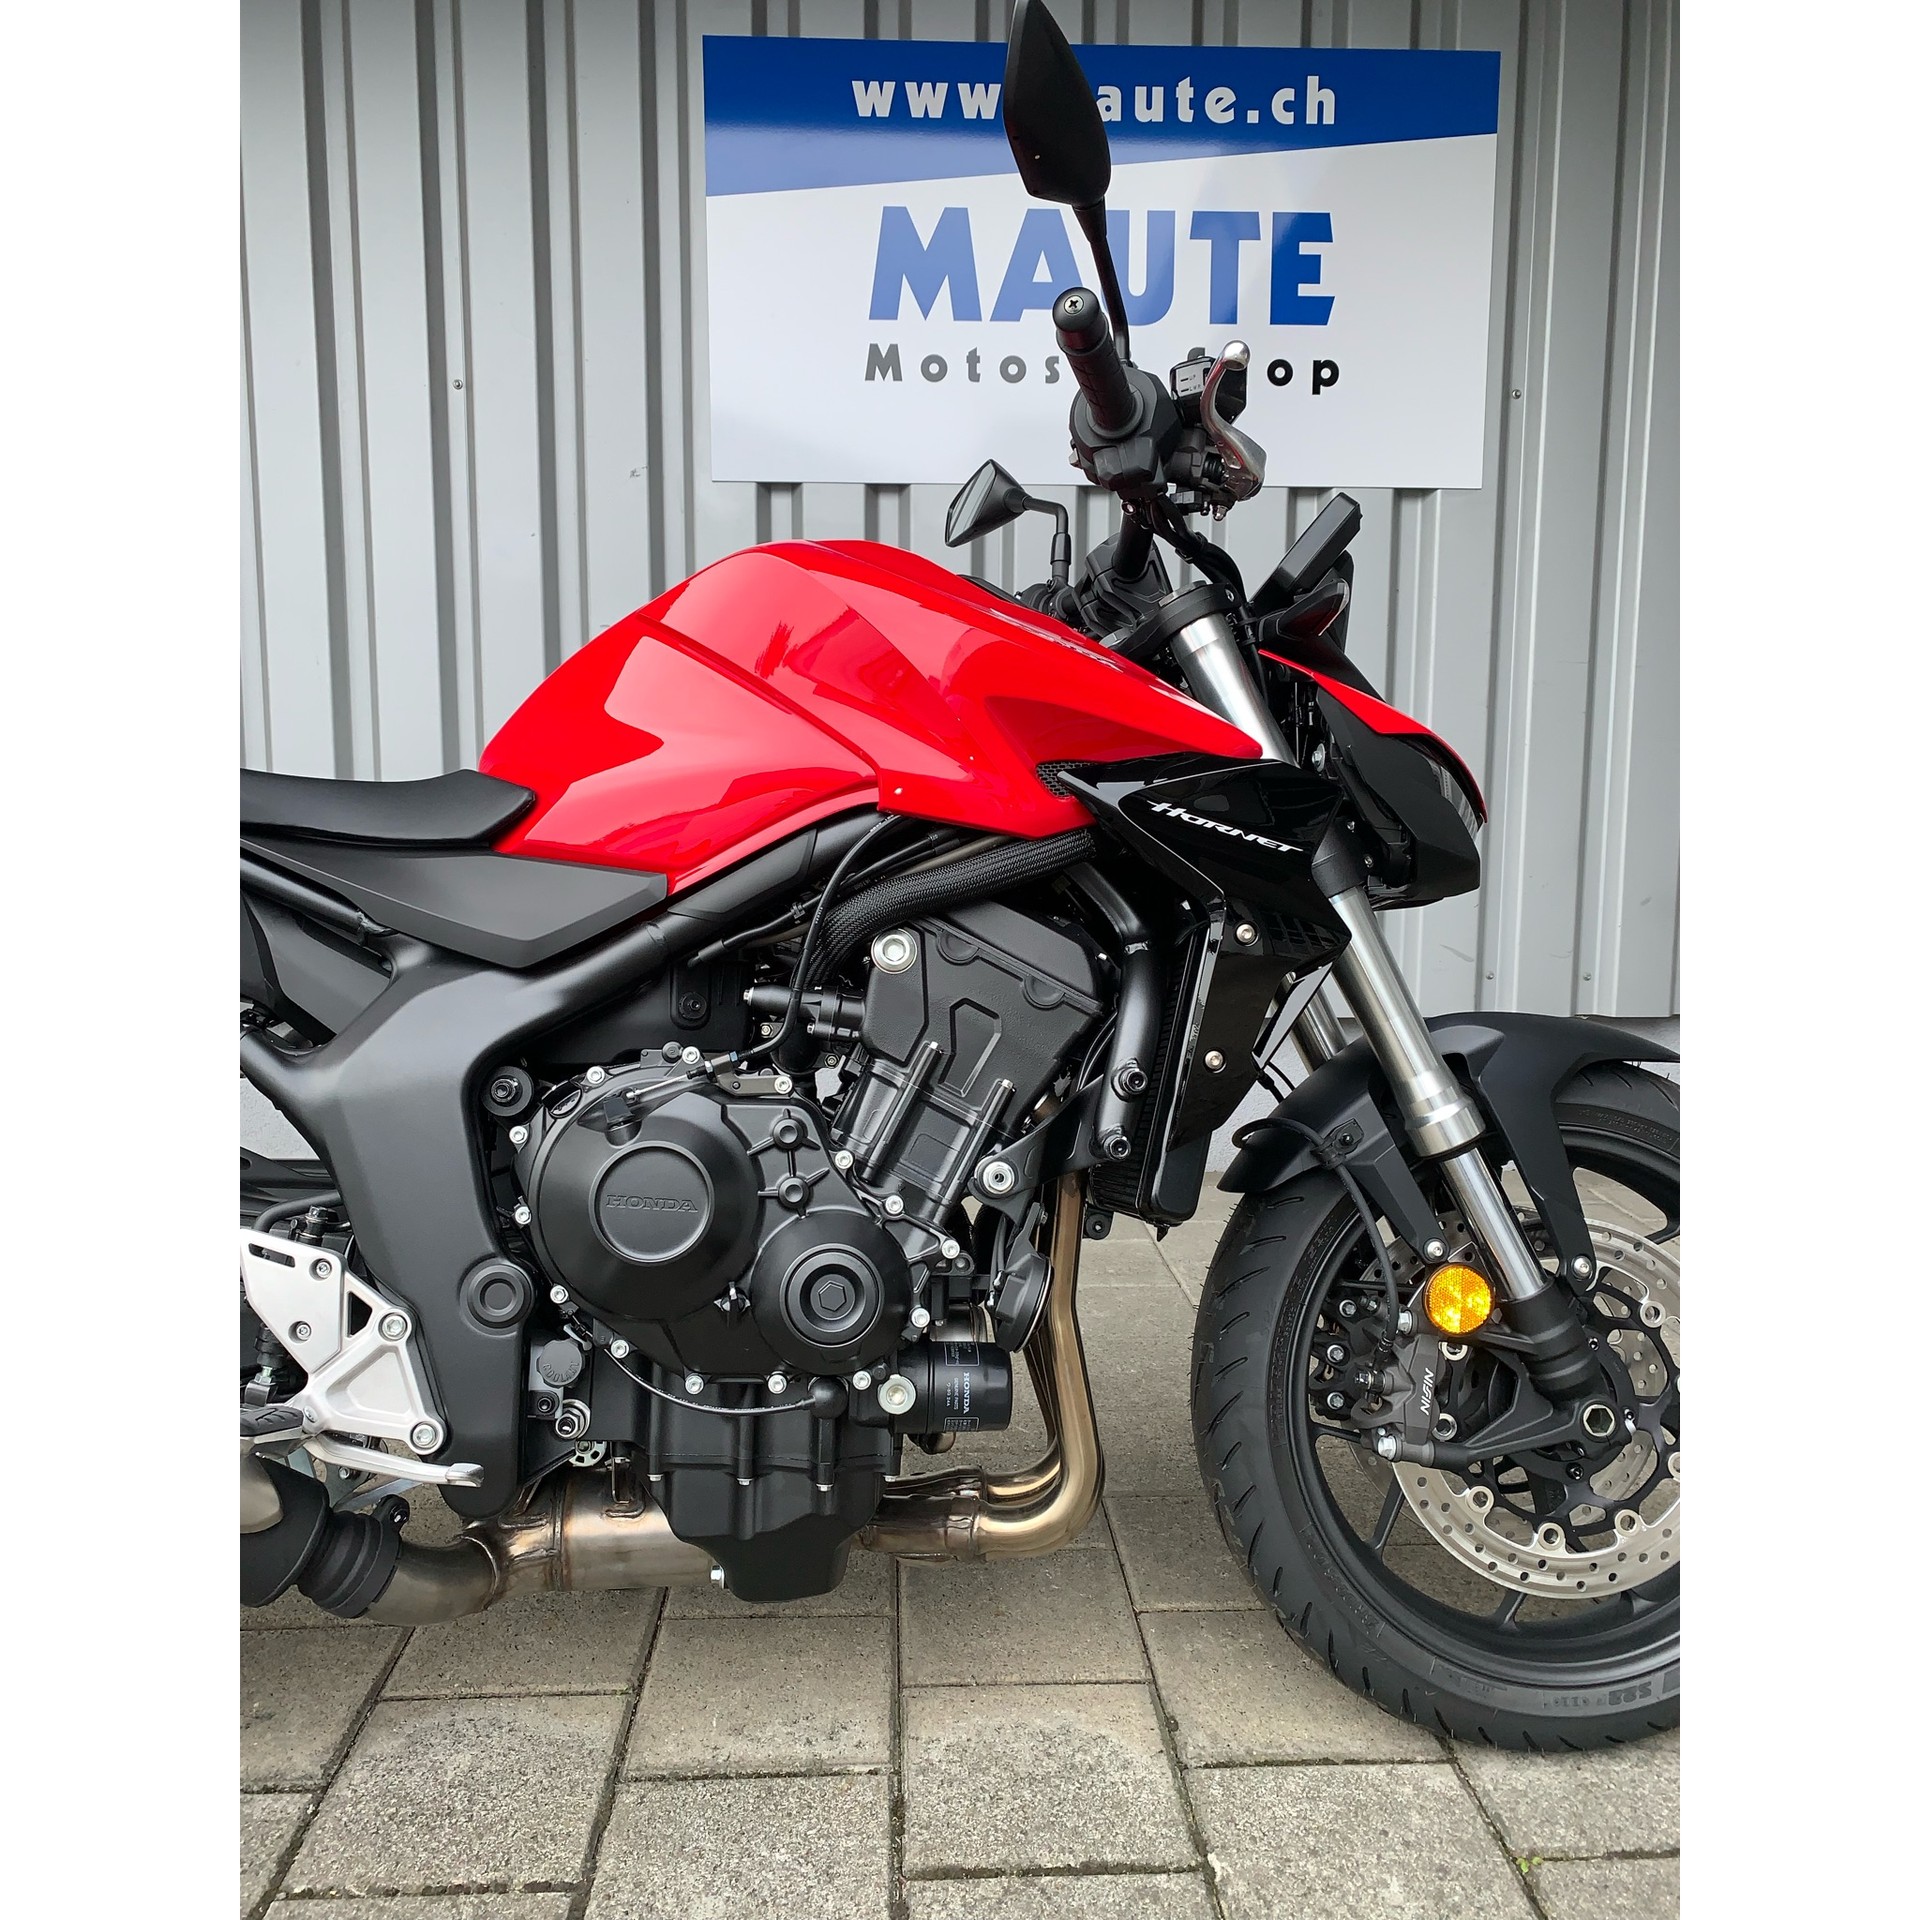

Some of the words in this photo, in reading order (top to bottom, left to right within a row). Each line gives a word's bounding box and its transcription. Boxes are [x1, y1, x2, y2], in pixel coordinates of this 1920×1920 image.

[852, 75, 1335, 125] wwwaute.ch
[868, 205, 1336, 327] MAUTE
[864, 342, 1061, 385] Motos
[1146, 799, 1304, 852] HORNET
[605, 1194, 699, 1213] HONDA
[1420, 1367, 1434, 1416] NISSIN
